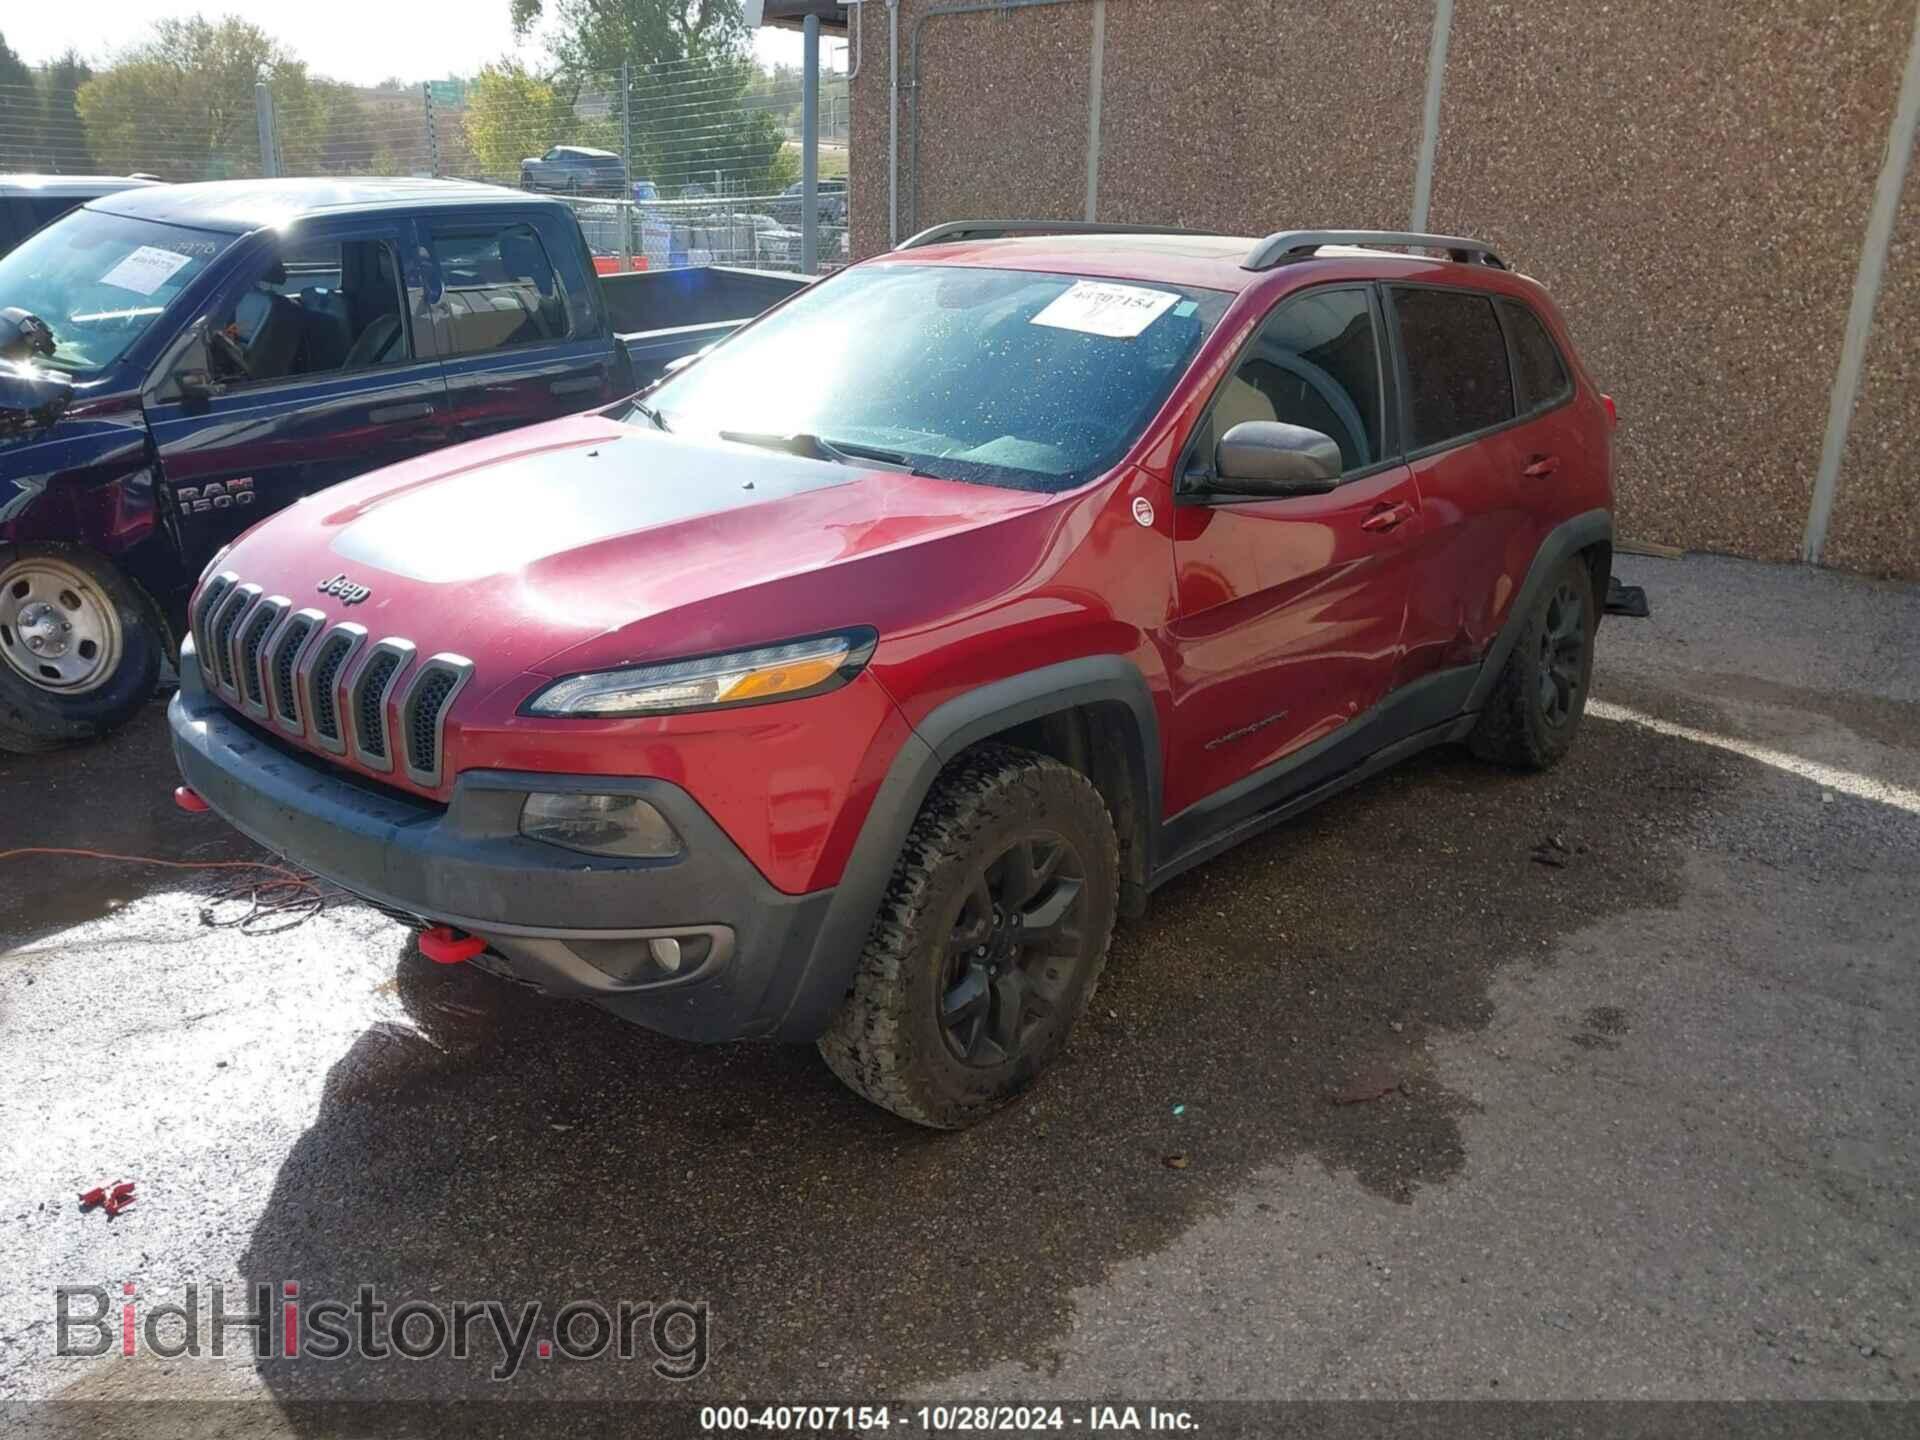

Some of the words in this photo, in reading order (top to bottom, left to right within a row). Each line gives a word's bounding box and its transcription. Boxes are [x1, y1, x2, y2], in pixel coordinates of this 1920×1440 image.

[177, 477, 254, 501] RAM
[180, 491, 255, 515] 1500
[317, 573, 371, 606] Jeep
